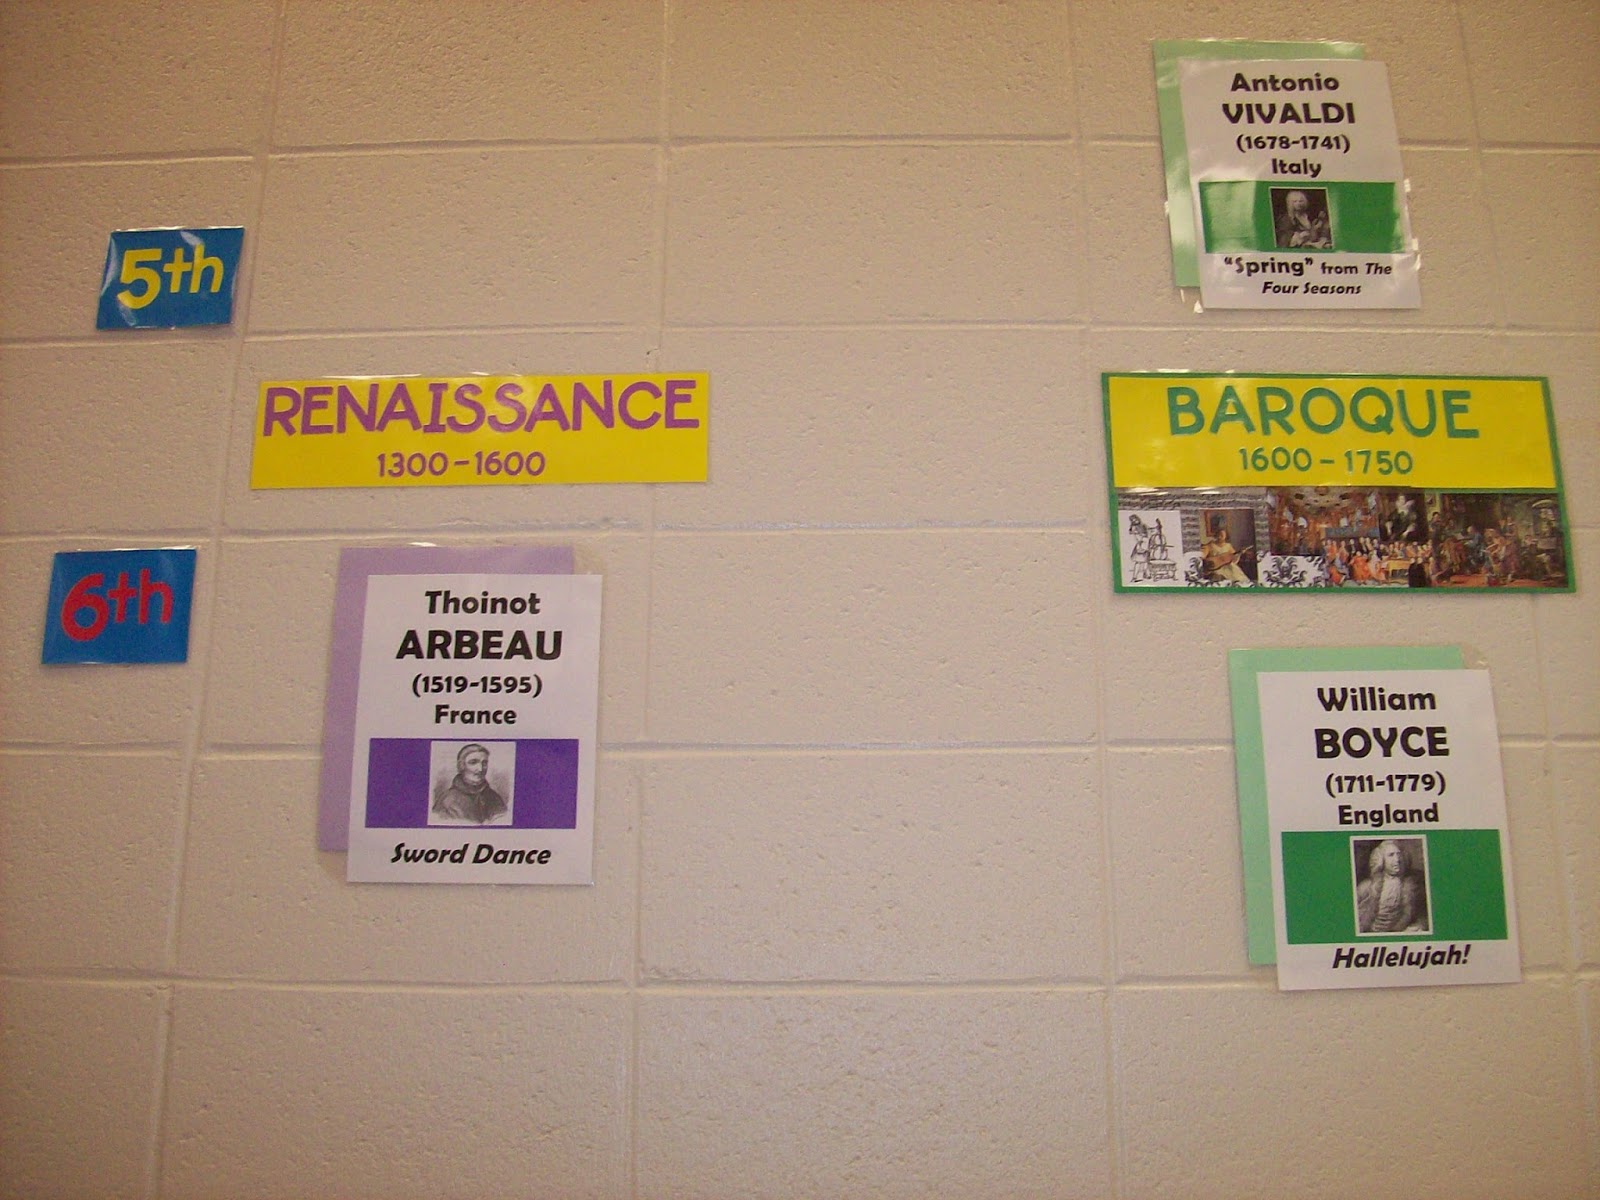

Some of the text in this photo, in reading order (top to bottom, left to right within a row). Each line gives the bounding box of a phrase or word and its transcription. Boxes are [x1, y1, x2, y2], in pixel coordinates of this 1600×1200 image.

[1230, 72, 1340, 92] Antonio
[1222, 102, 1356, 124] VIVALDI
[1236, 133, 1351, 154] (1678-1741)
[1271, 158, 1322, 178] Italy
[117, 246, 224, 309] 5th
[1321, 262, 1358, 275] from
[1364, 262, 1393, 275] The
[1261, 281, 1362, 295] Four Seasons
[263, 380, 700, 436] RENAISSANCE
[1166, 385, 1479, 438] BAROQUE
[61, 568, 173, 641] 6th
[425, 590, 541, 615] Thoinot
[395, 629, 563, 660] ARBEAU
[412, 673, 543, 698] (1519-1595)
[1317, 686, 1437, 711] William
[434, 704, 517, 725] France
[1314, 726, 1450, 759] BOYCE
[1325, 771, 1446, 798] (1711-1779)
[1338, 802, 1440, 827] England
[390, 842, 551, 865] Sword Dance
[1332, 944, 1471, 970] Hallelujah!
